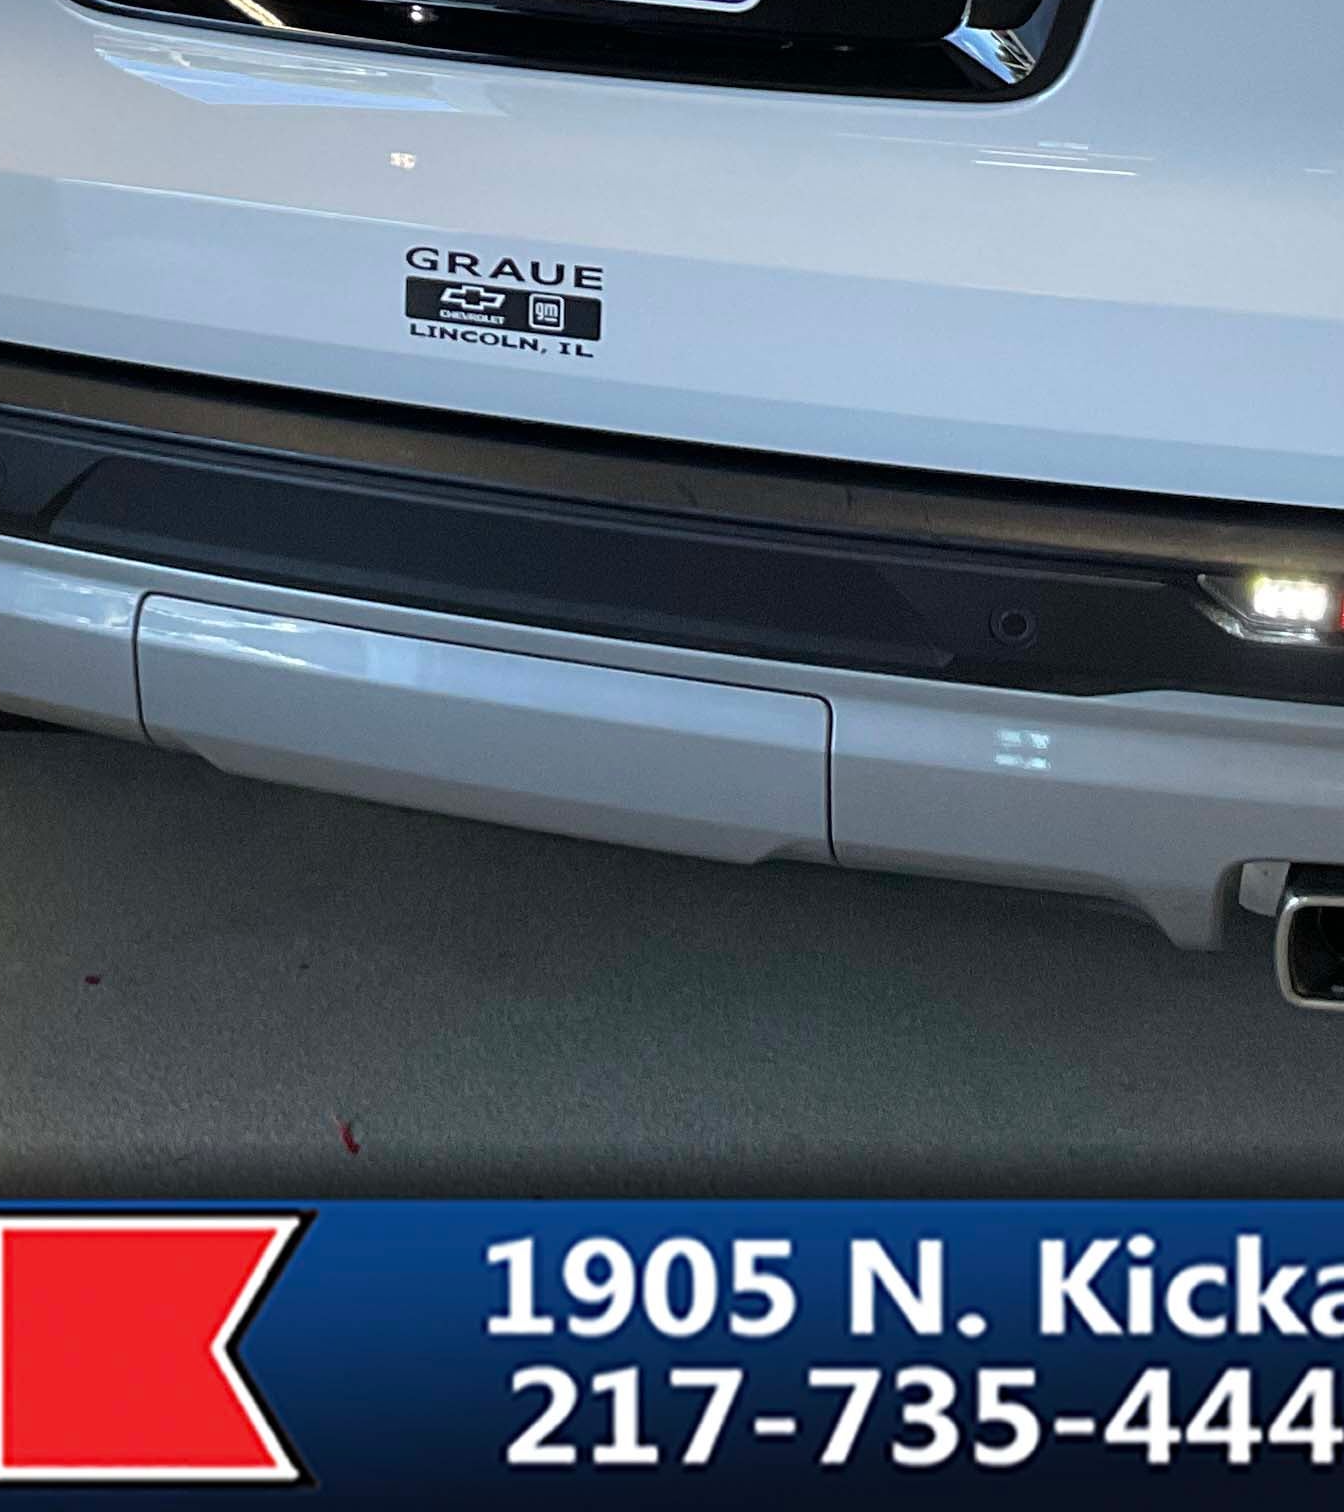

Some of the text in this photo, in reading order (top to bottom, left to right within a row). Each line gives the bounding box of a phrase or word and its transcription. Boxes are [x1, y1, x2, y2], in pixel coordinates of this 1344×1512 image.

[405, 246, 604, 291] GRAUE
[439, 309, 505, 325] CHEVROLET
[410, 323, 594, 358] LINCOLN, IL
